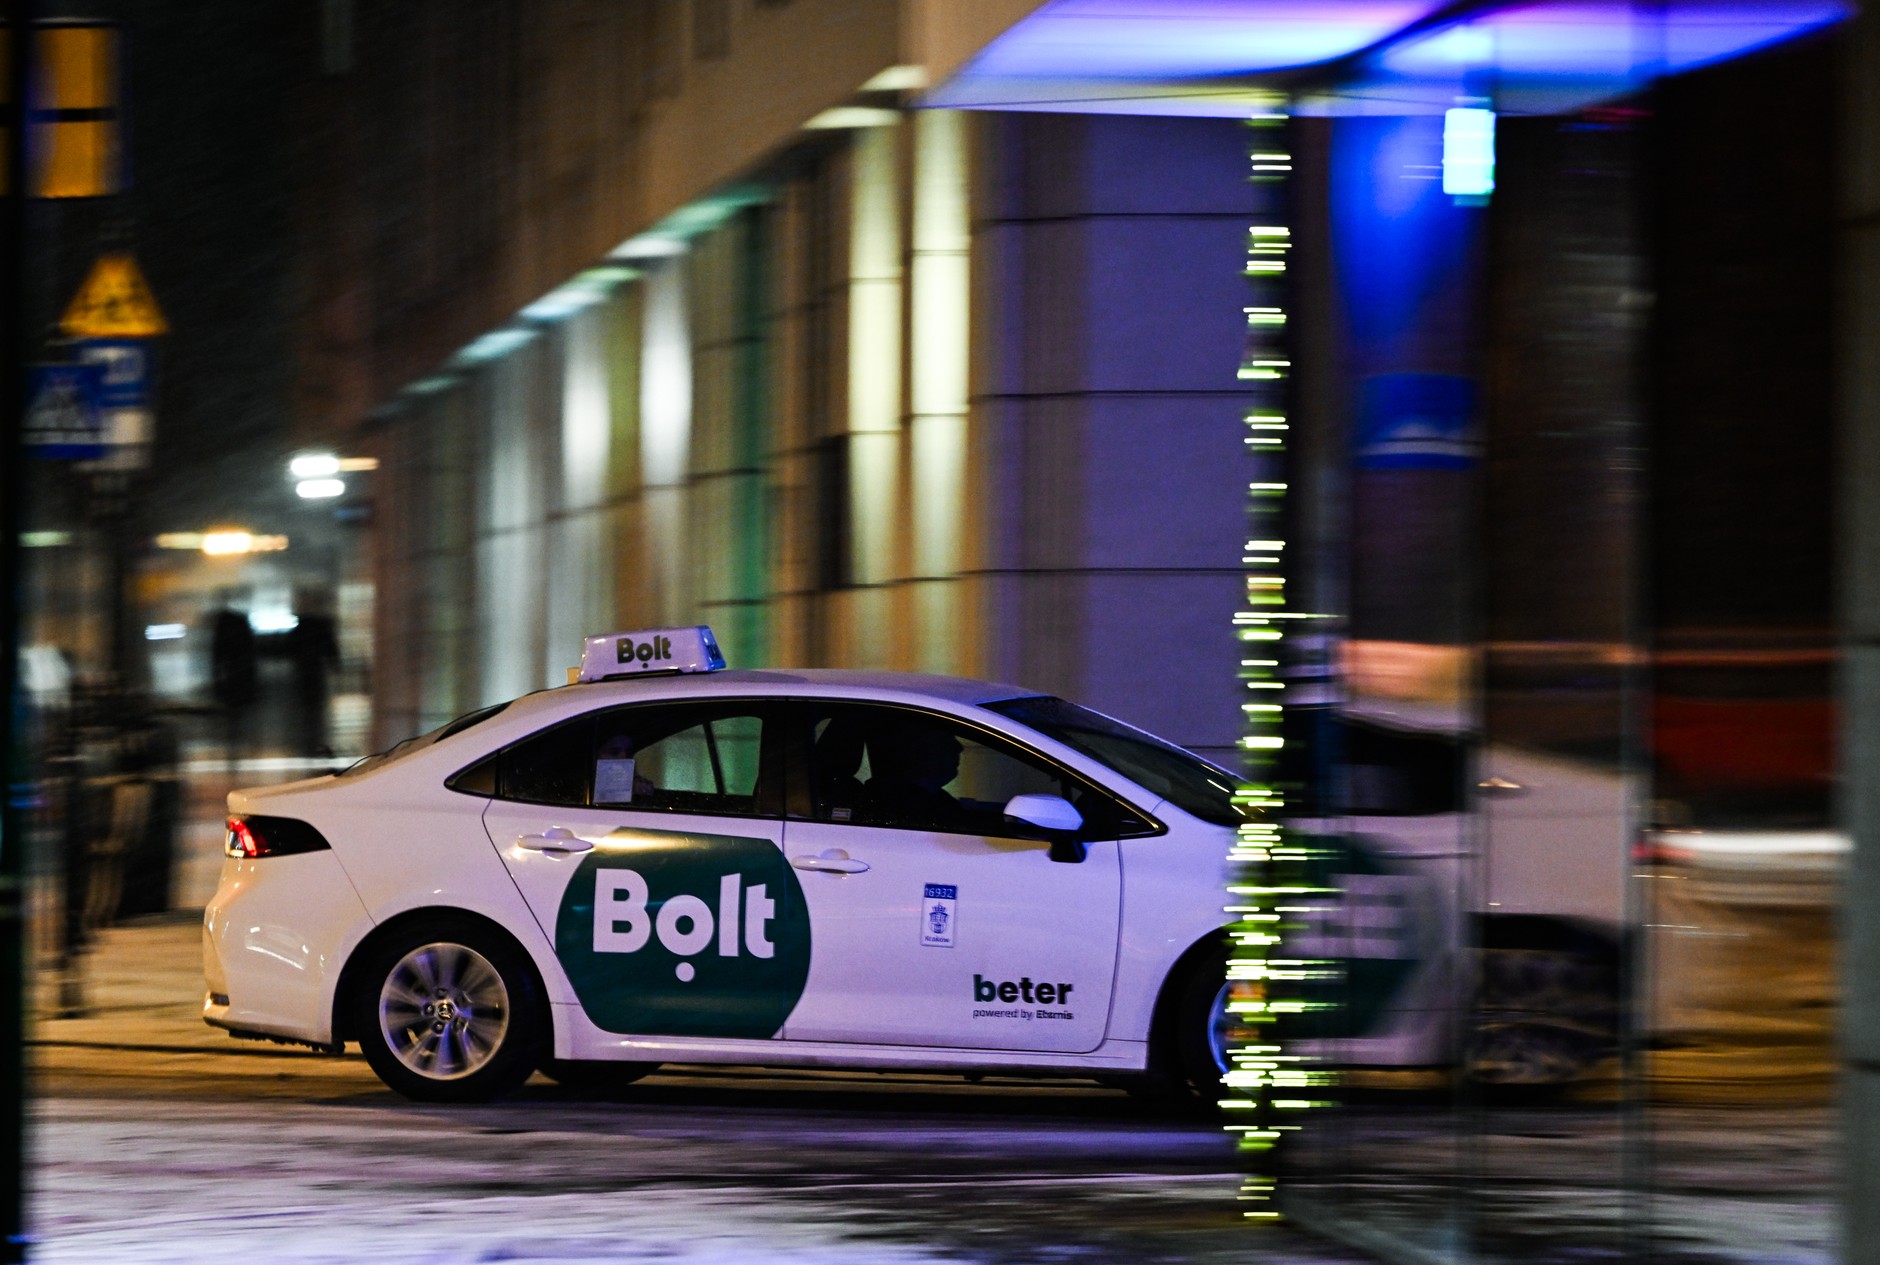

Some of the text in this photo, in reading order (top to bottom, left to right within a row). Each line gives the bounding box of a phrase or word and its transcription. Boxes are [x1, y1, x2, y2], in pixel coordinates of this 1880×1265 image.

[616, 635, 672, 669] Bolt
[593, 868, 776, 982] Bolt
[973, 974, 1074, 1005] beter
[973, 1009, 1018, 1019] powered
[1020, 1009, 1033, 1020] by
